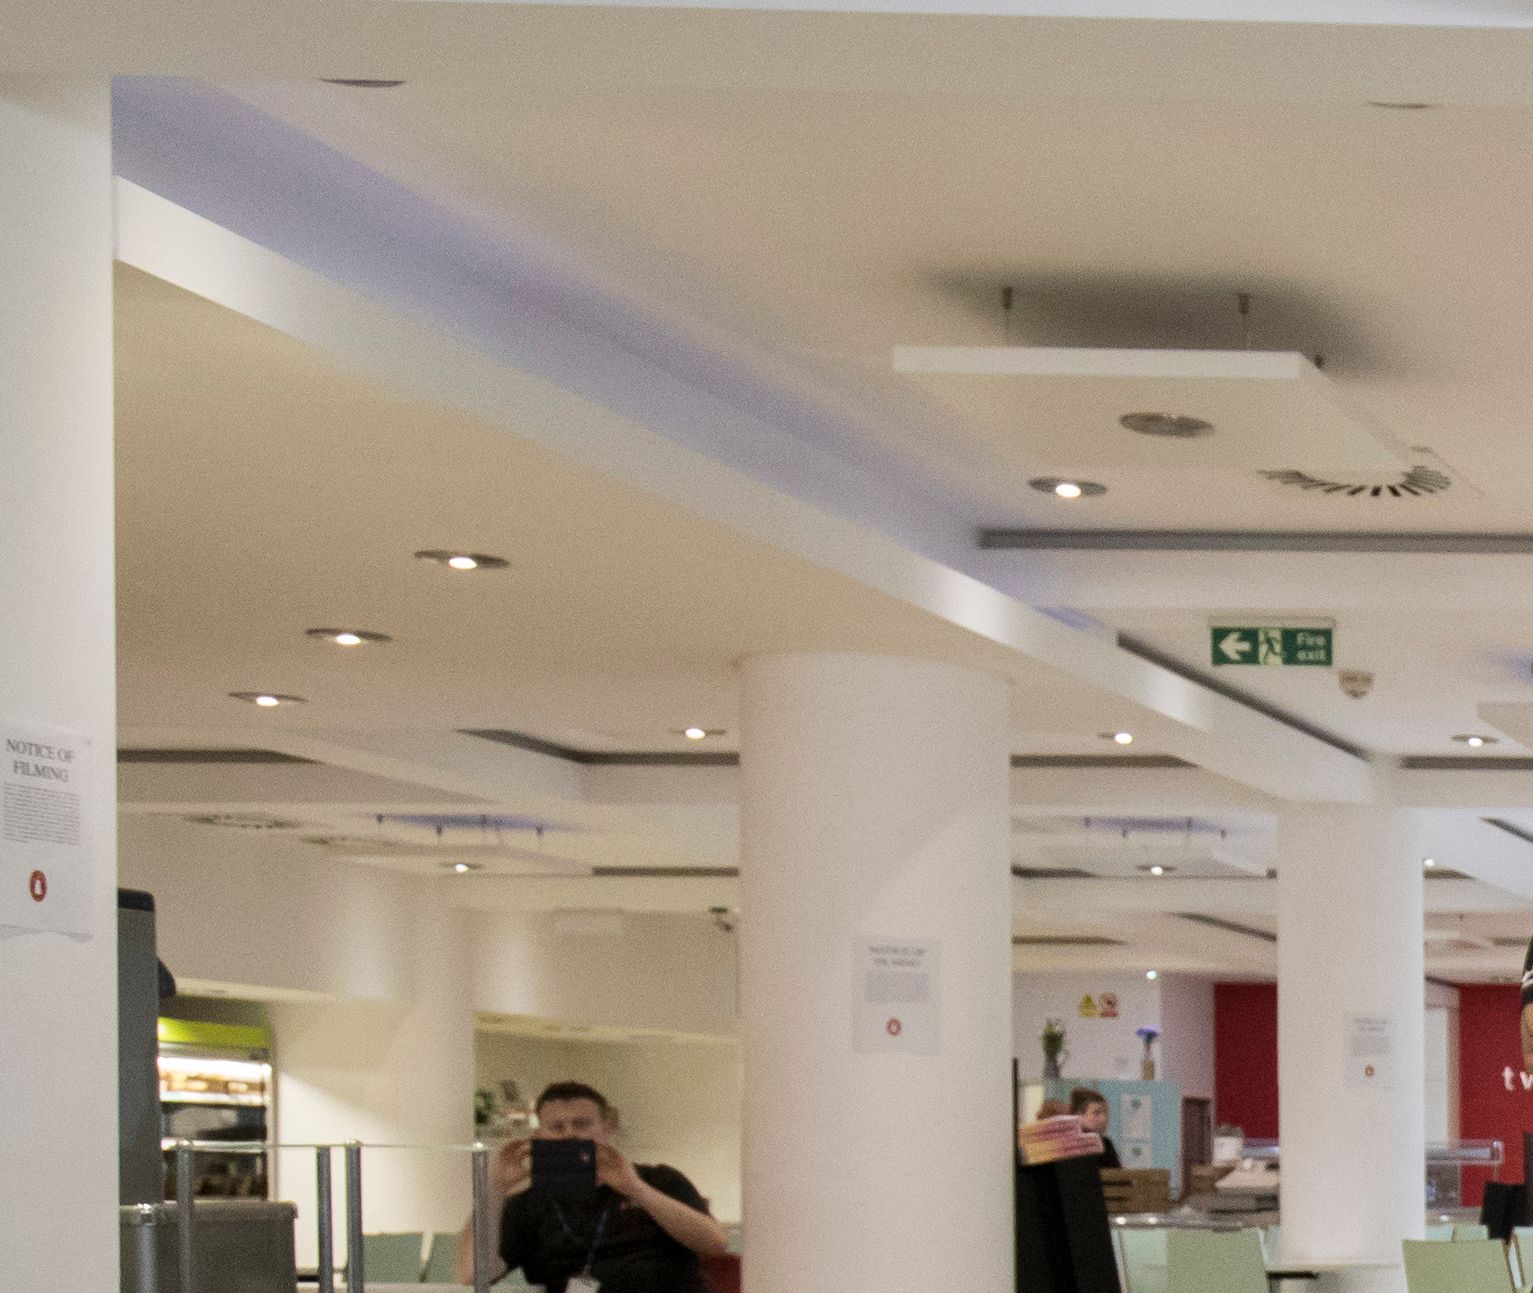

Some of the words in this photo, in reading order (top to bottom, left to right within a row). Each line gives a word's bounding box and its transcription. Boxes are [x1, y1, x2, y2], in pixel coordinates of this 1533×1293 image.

[5, 739, 54, 760] NOTICE
[57, 748, 74, 762] OF
[13, 760, 69, 782] FILMING
